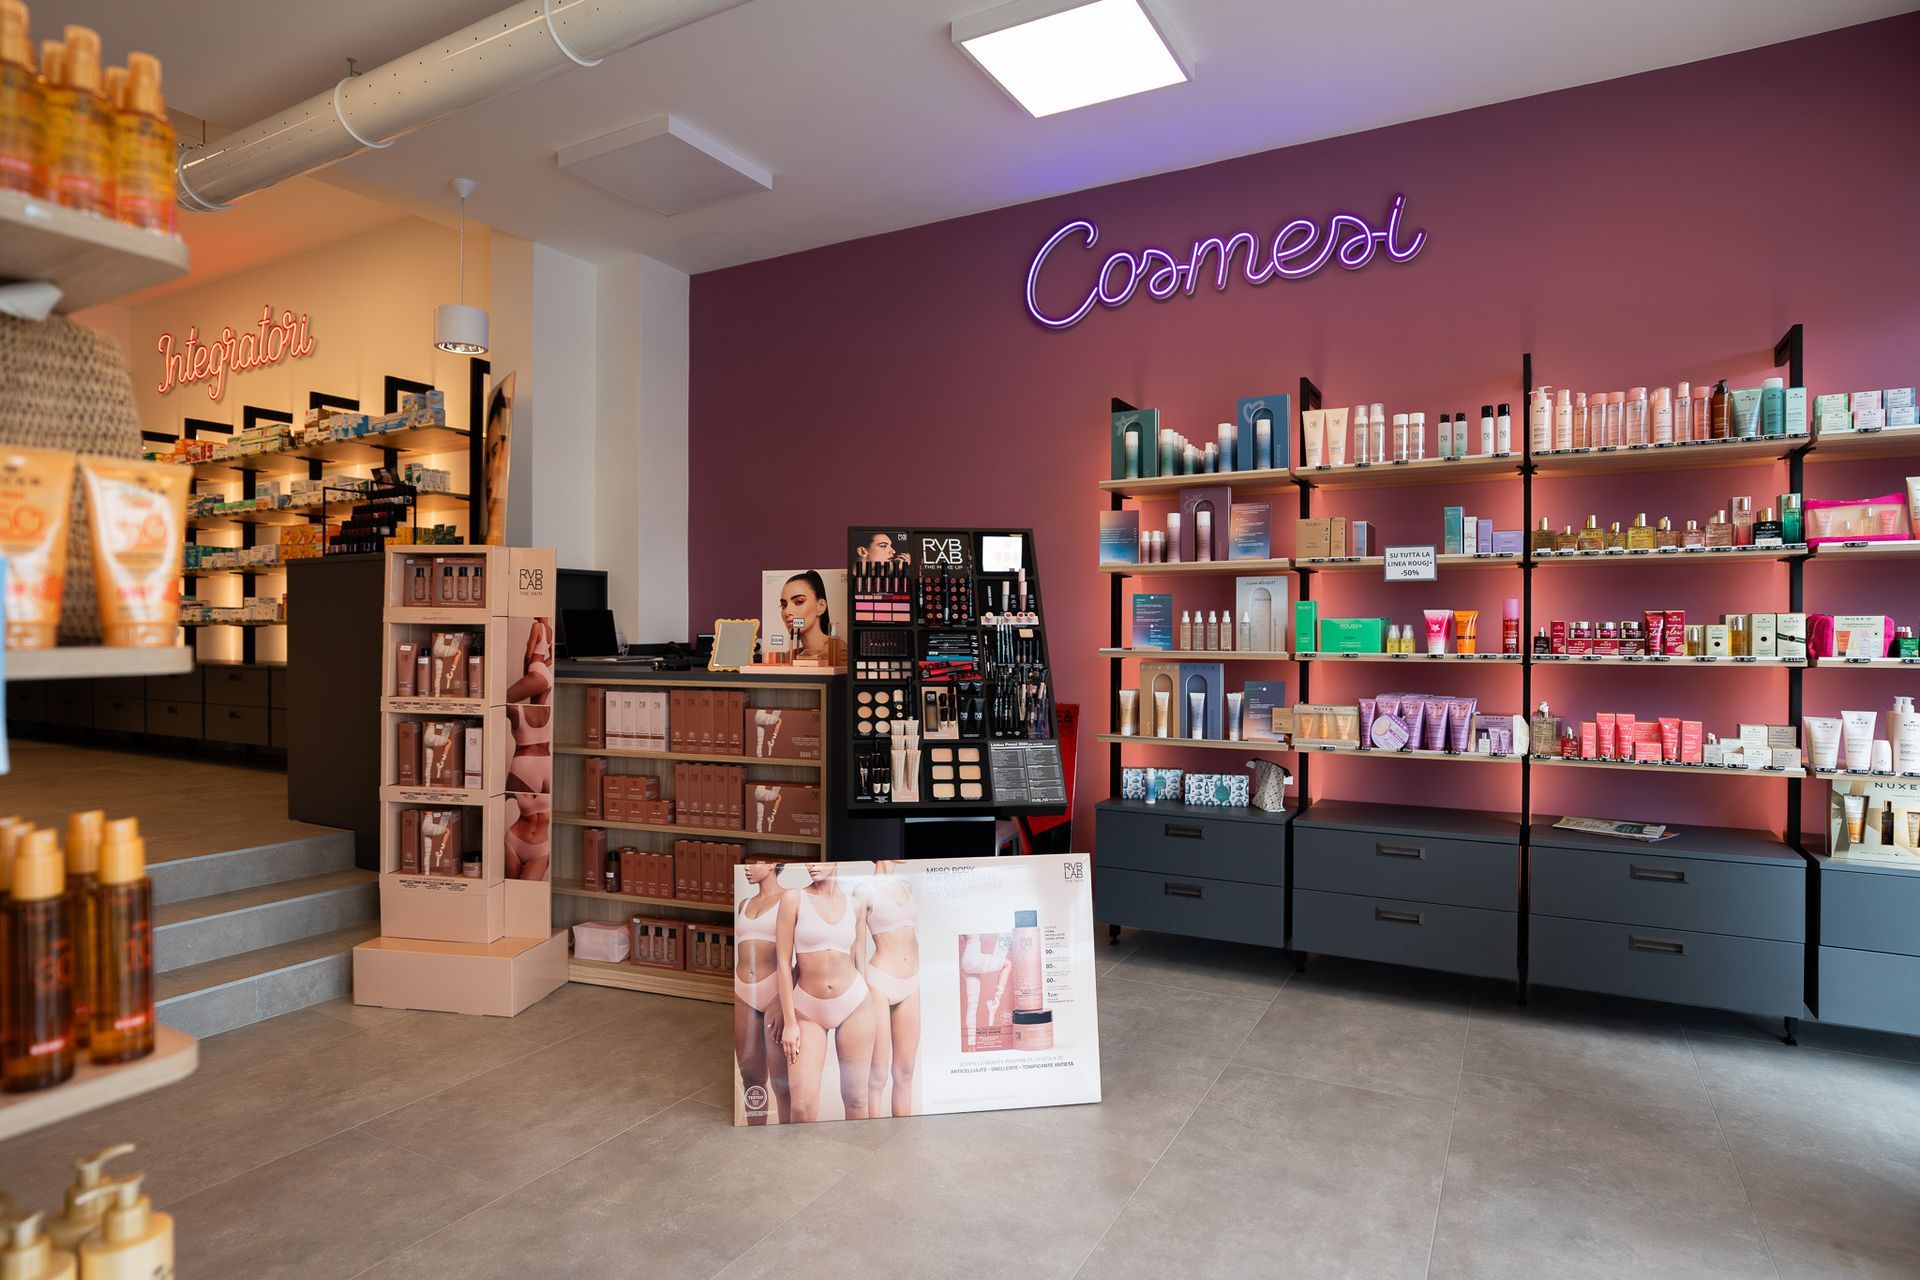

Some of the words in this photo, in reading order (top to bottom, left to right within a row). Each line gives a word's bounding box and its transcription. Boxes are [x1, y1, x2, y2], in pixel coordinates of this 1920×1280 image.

[1026, 193, 1427, 330] Cosmesi
[158, 304, 314, 400] Integratori
[922, 538, 962, 551] RVB
[923, 551, 963, 564] LAB
[519, 568, 543, 580] RVB
[519, 579, 543, 590] LAB
[1874, 782, 1918, 790] NUXE
[1064, 862, 1083, 871] RVB
[1065, 870, 1084, 879] LAB
